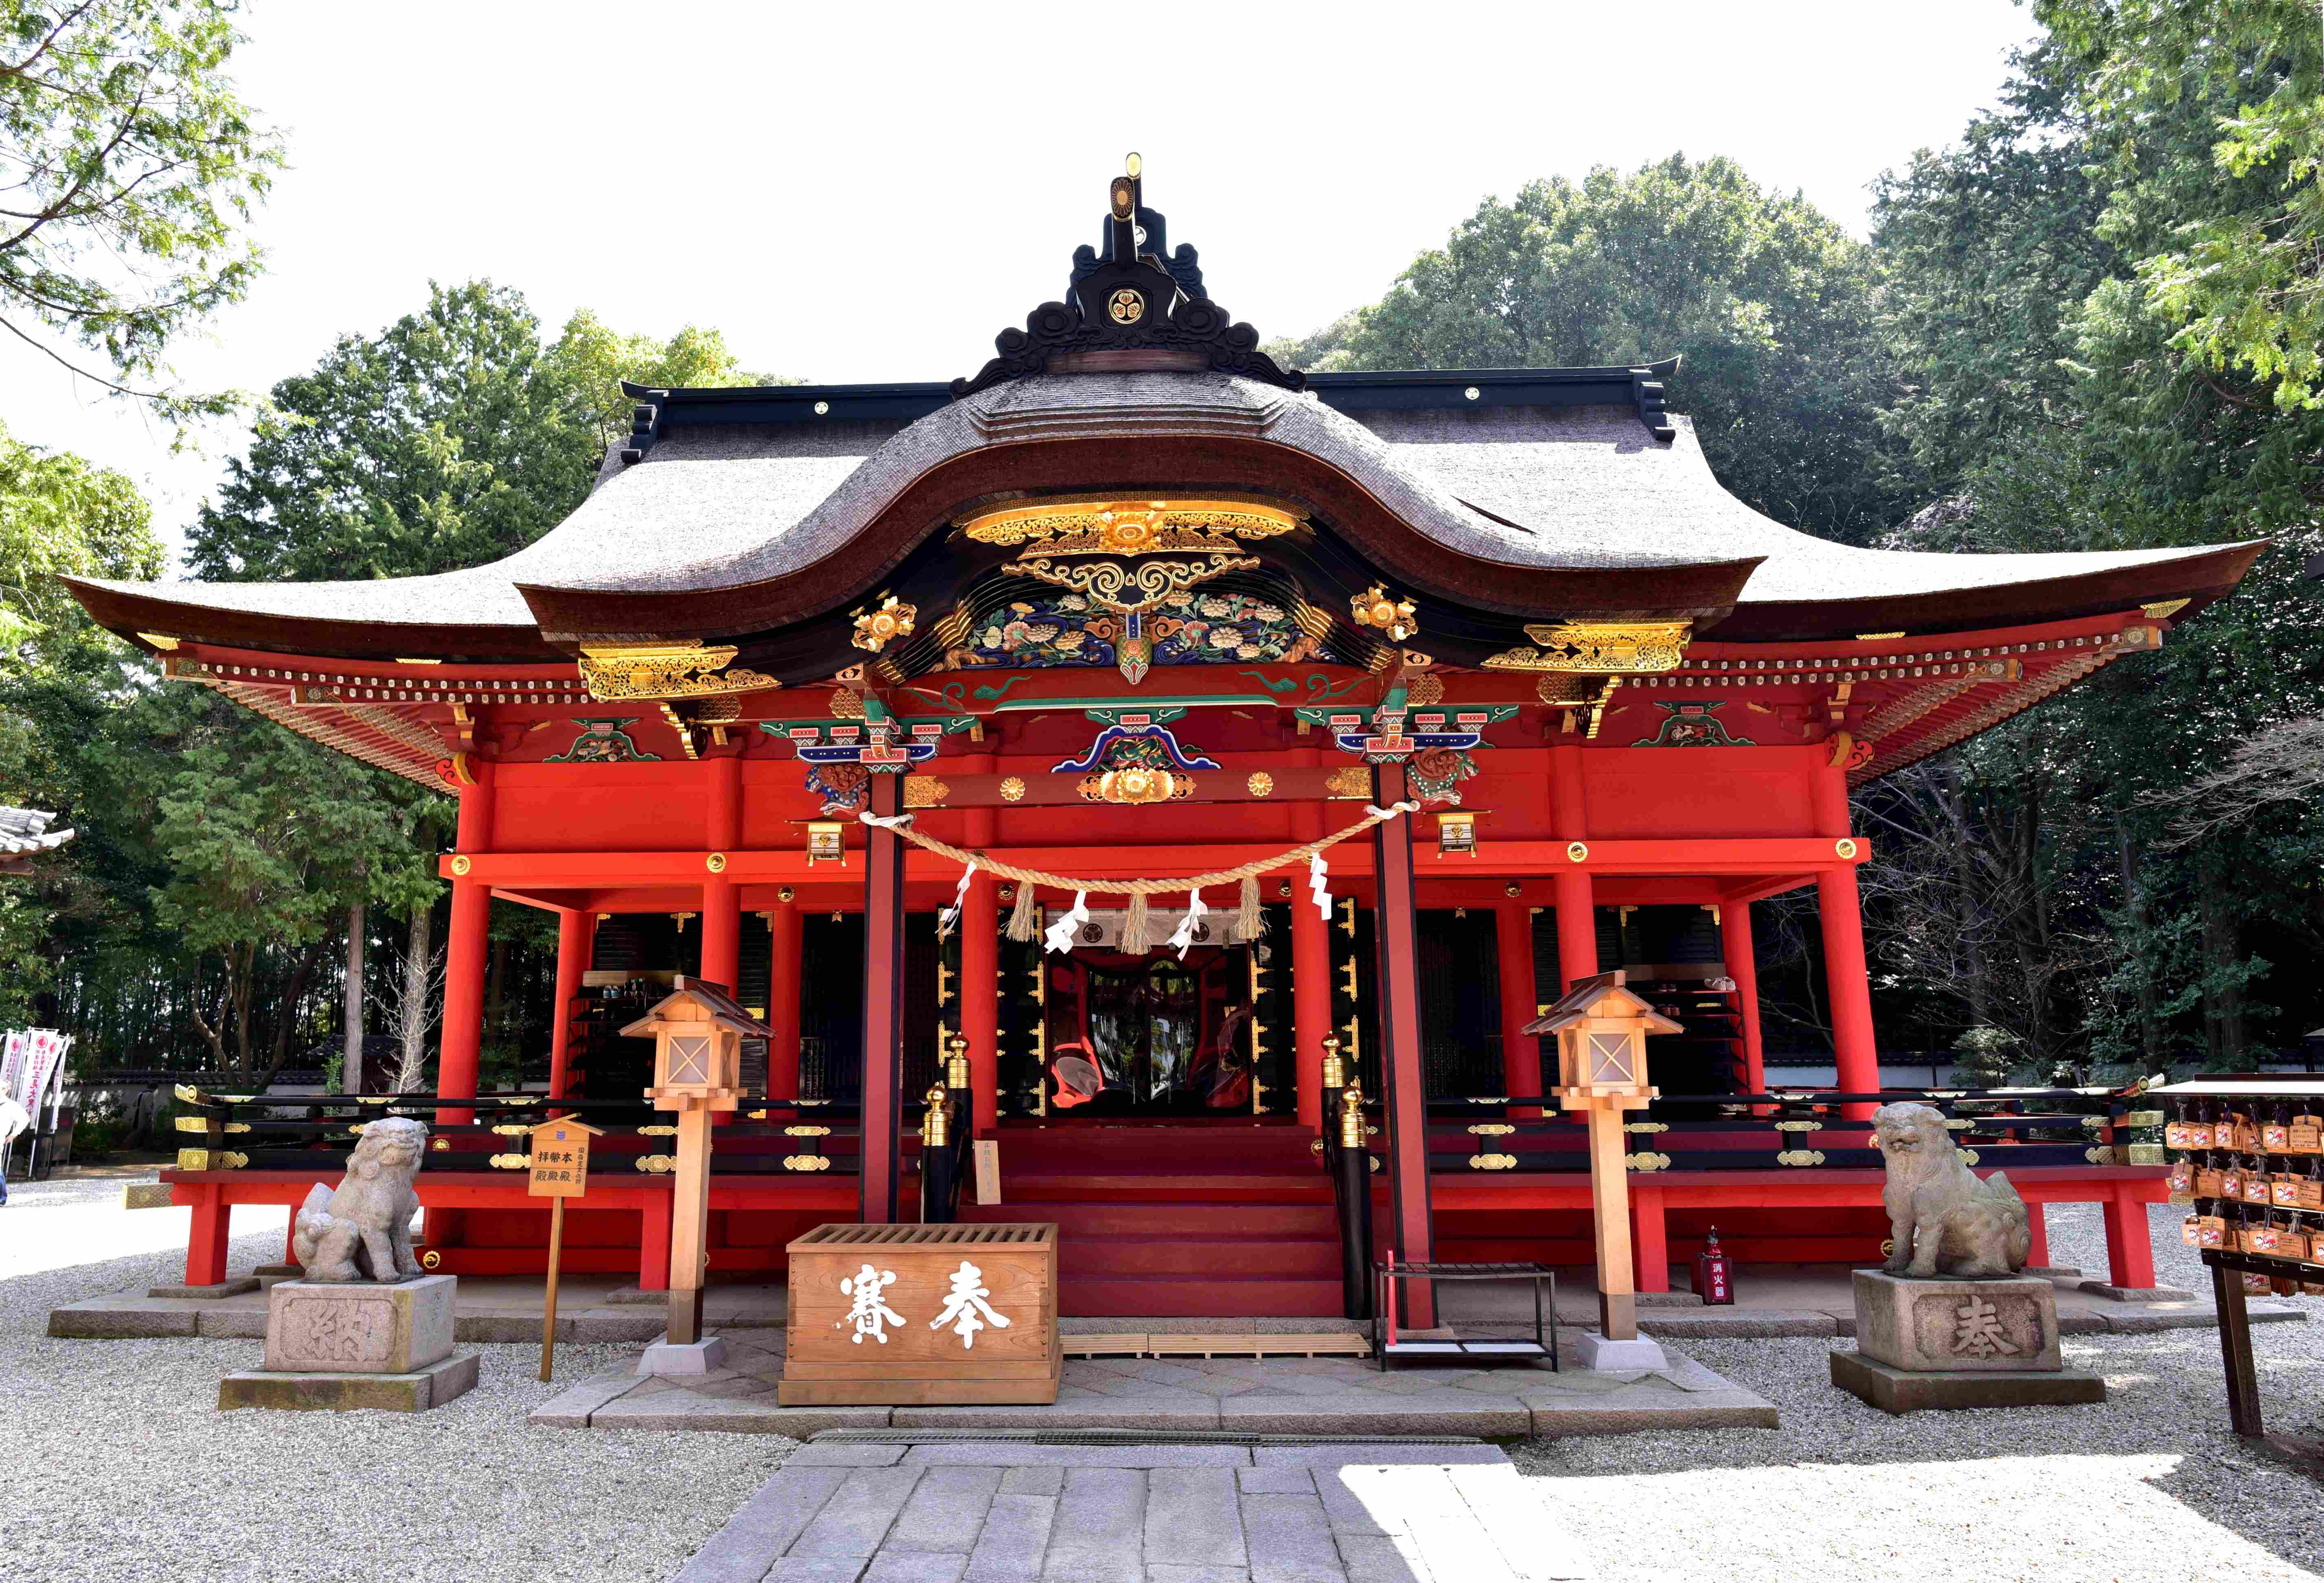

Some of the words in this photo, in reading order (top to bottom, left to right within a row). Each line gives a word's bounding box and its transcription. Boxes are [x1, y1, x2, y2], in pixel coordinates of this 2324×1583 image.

[1712, 1263, 1724, 1297] 消火器
[306, 1299, 371, 1361] 納
[1953, 1295, 2021, 1359] 奉
